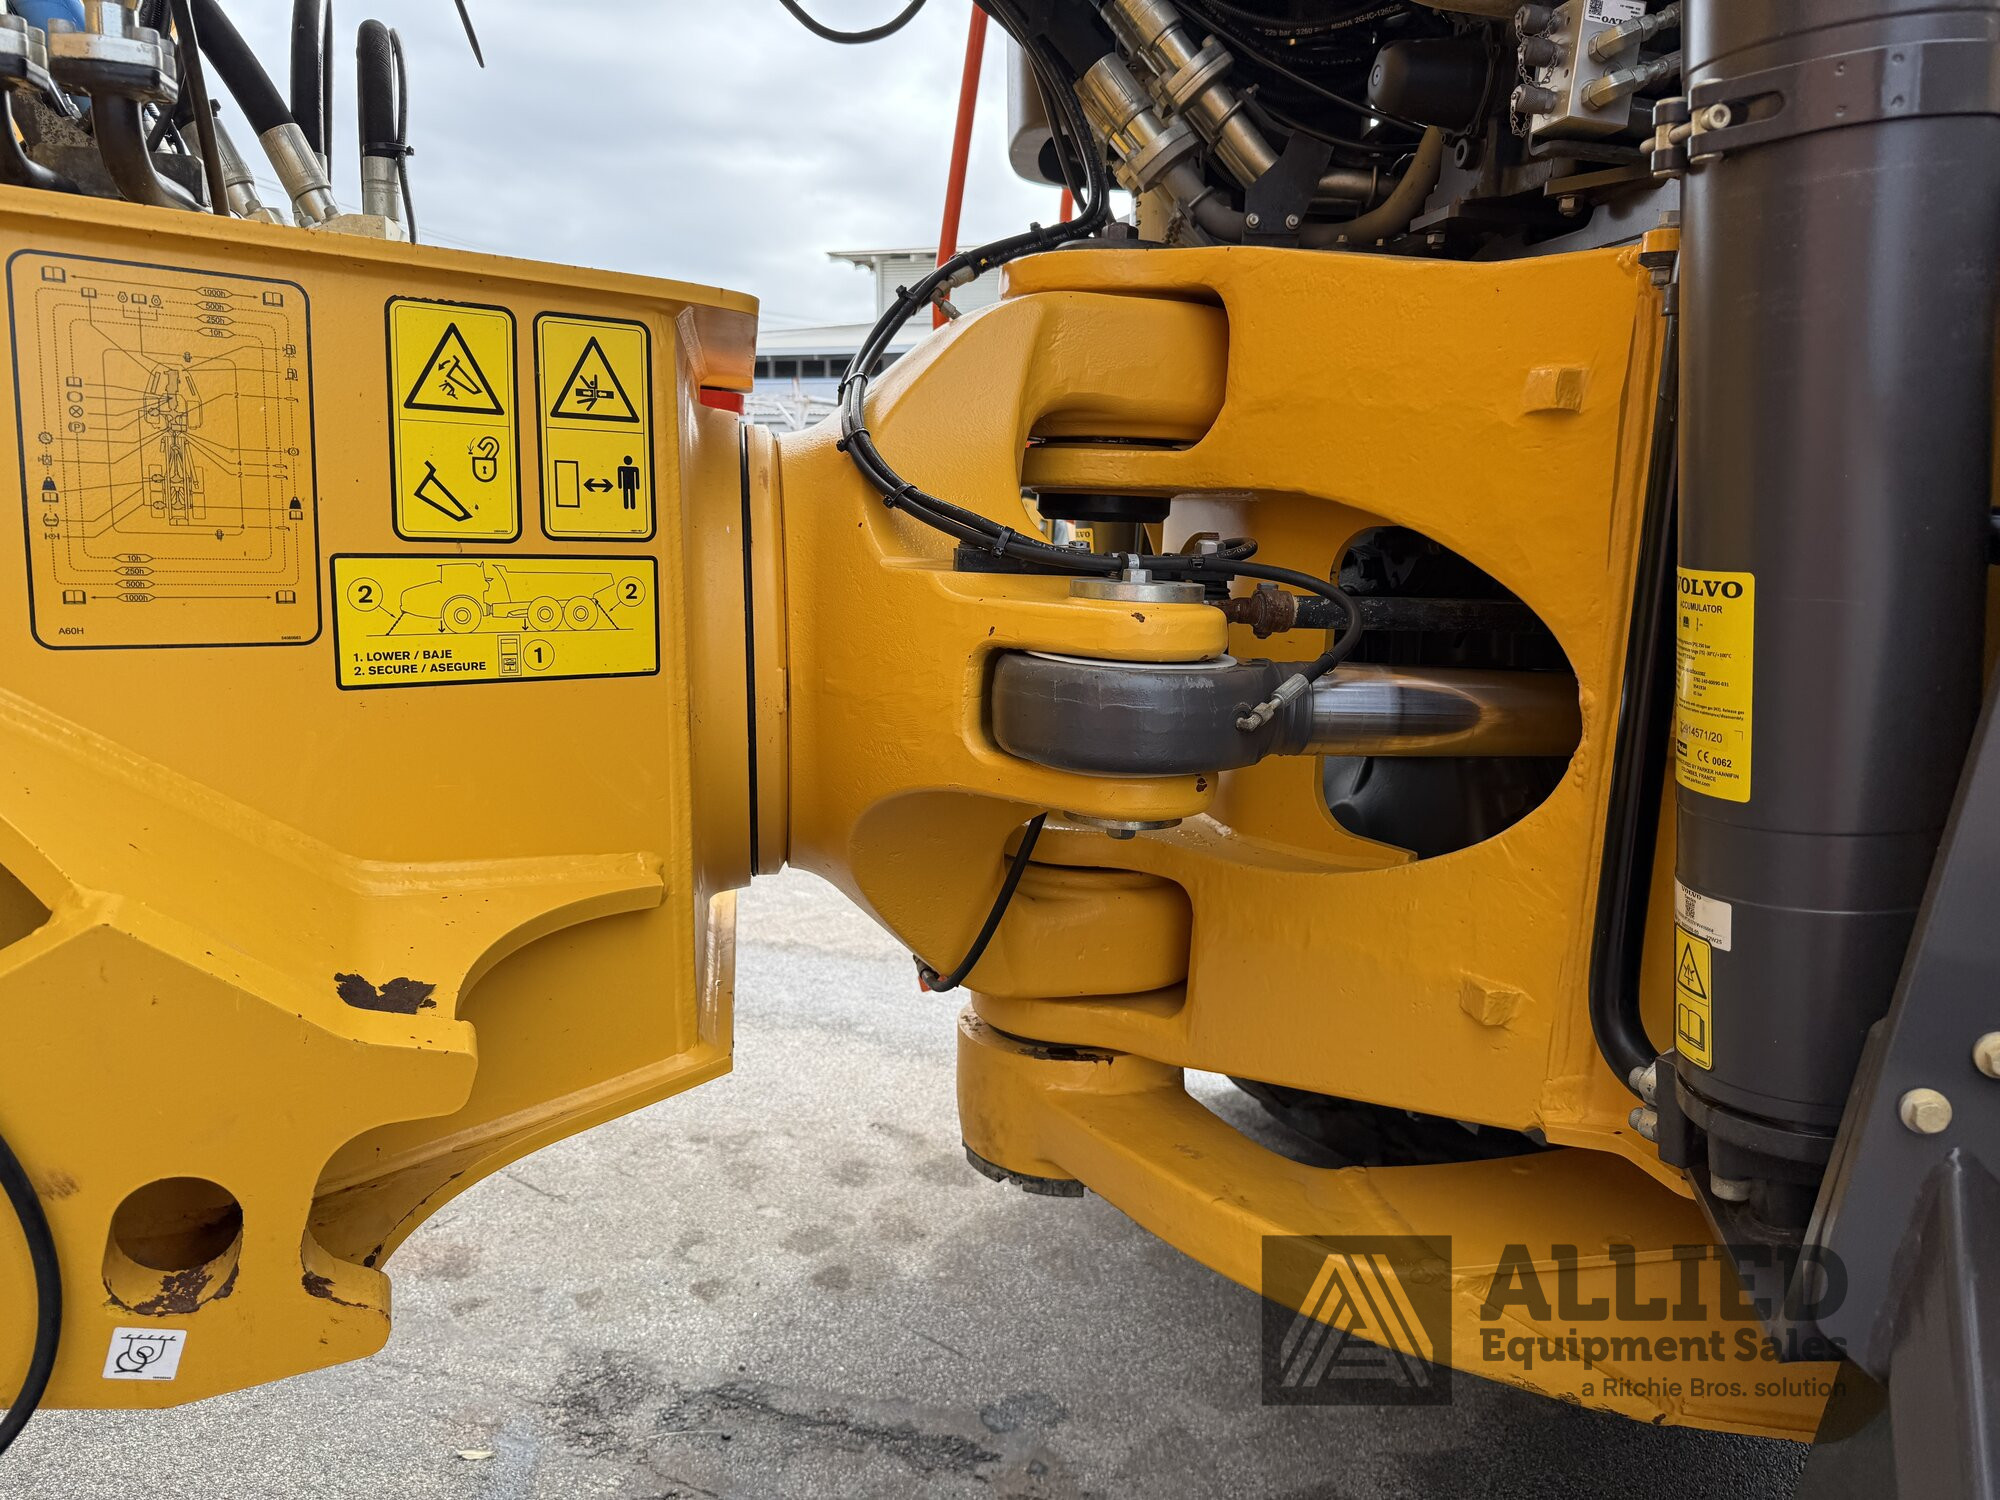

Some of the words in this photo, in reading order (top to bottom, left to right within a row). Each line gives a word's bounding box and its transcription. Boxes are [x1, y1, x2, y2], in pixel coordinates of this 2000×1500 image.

[204, 289, 226, 298] 1000h
[206, 302, 224, 312] 500h
[206, 316, 225, 324] 250h
[210, 329, 224, 337] 10h
[127, 554, 141, 562] 10h
[125, 567, 144, 576] 250h
[126, 580, 145, 588] 500h
[357, 586, 373, 603] 2
[625, 584, 638, 600] 2
[125, 593, 148, 602] 1000h
[58, 627, 84, 636] A60H
[353, 652, 364, 662] 1.
[366, 651, 410, 662] LOWER
[423, 650, 452, 660] BAJE
[534, 648, 543, 662] 1
[354, 666, 365, 676] 2.
[368, 663, 418, 675] SECURE
[430, 662, 486, 674] ASEGURE
[1712, 756, 1732, 768] 0062
[1681, 885, 1702, 900] VOLVO
